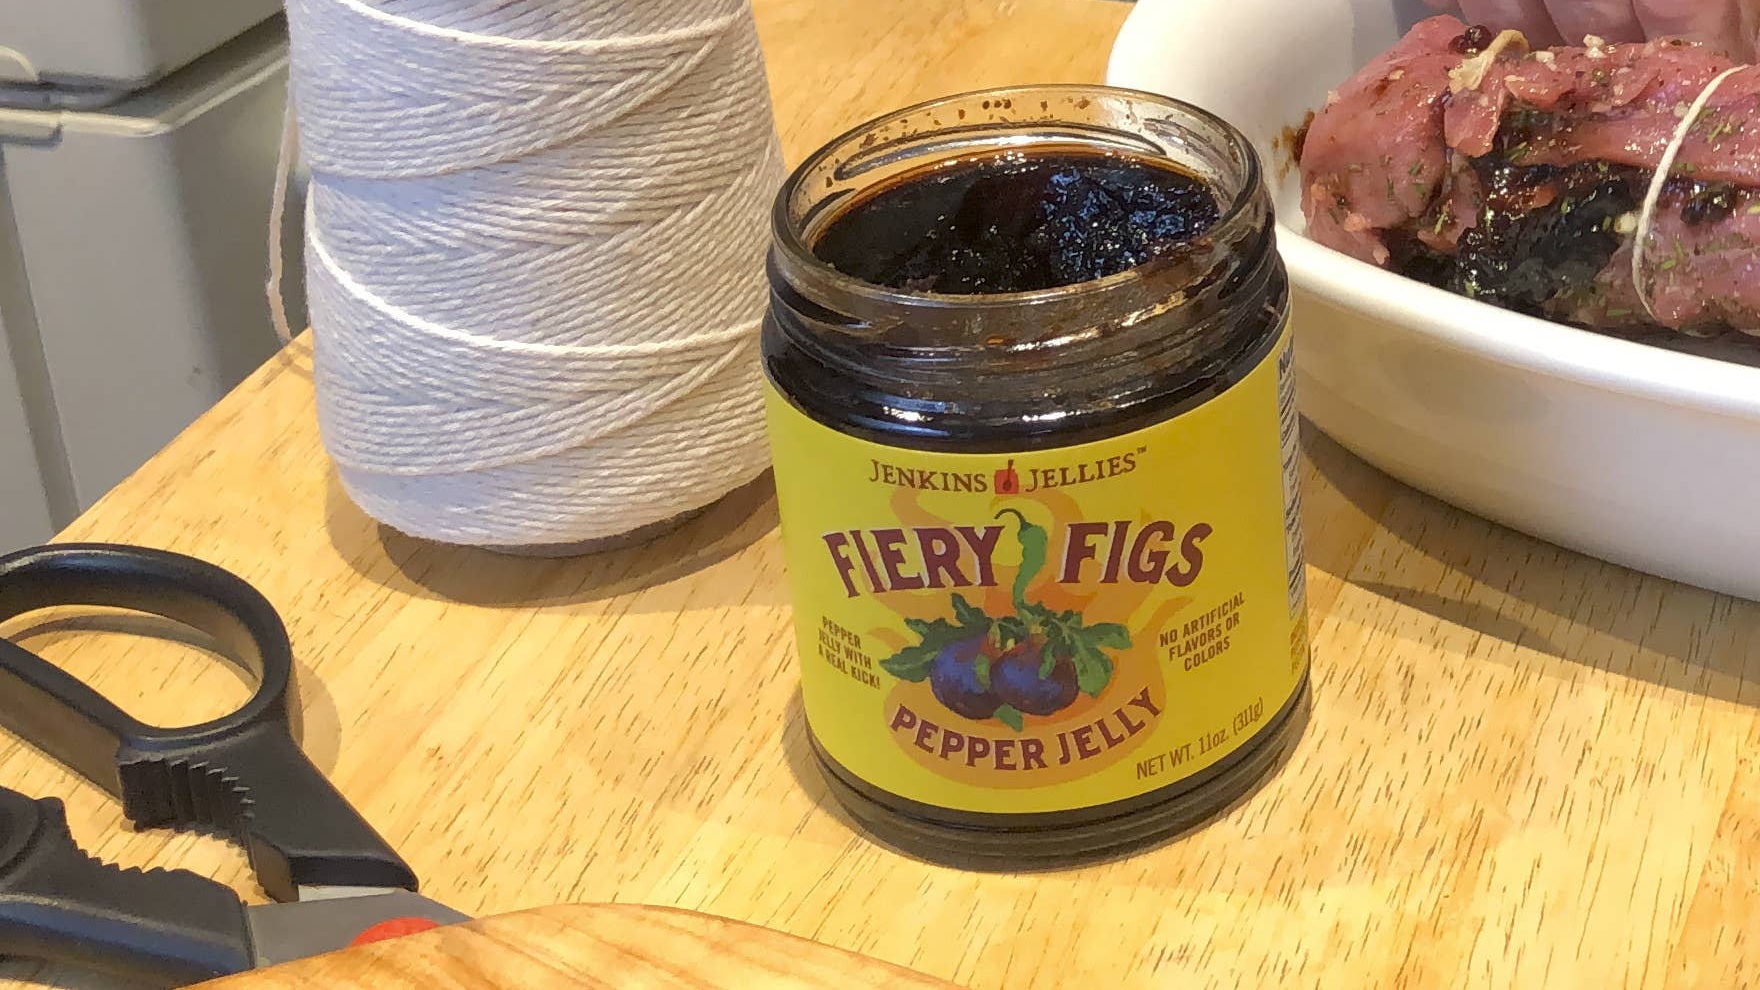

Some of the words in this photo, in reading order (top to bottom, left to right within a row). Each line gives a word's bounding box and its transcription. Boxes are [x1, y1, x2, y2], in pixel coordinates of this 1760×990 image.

[869, 459, 988, 492] JENKINS
[822, 525, 1005, 598] FIERY
[1056, 520, 1213, 587] FIGS
[822, 615, 861, 650] PEPPER
[1160, 629, 1178, 647] NO
[1182, 592, 1245, 638] ARTIFICIAL
[1169, 623, 1222, 661] FLAVORS
[1226, 612, 1240, 631] OR
[819, 628, 841, 654] JELLY
[844, 646, 872, 670] WITH
[819, 643, 824, 658] A
[825, 649, 848, 675] REAL
[851, 665, 880, 690] KICK!
[1184, 636, 1230, 671] COLORS
[890, 703, 1048, 770] PEPPER
[1056, 687, 1161, 765] JELLY
[1136, 753, 1167, 780] NET
[1169, 743, 1195, 768] WT.
[1199, 729, 1230, 756] 11oz.
